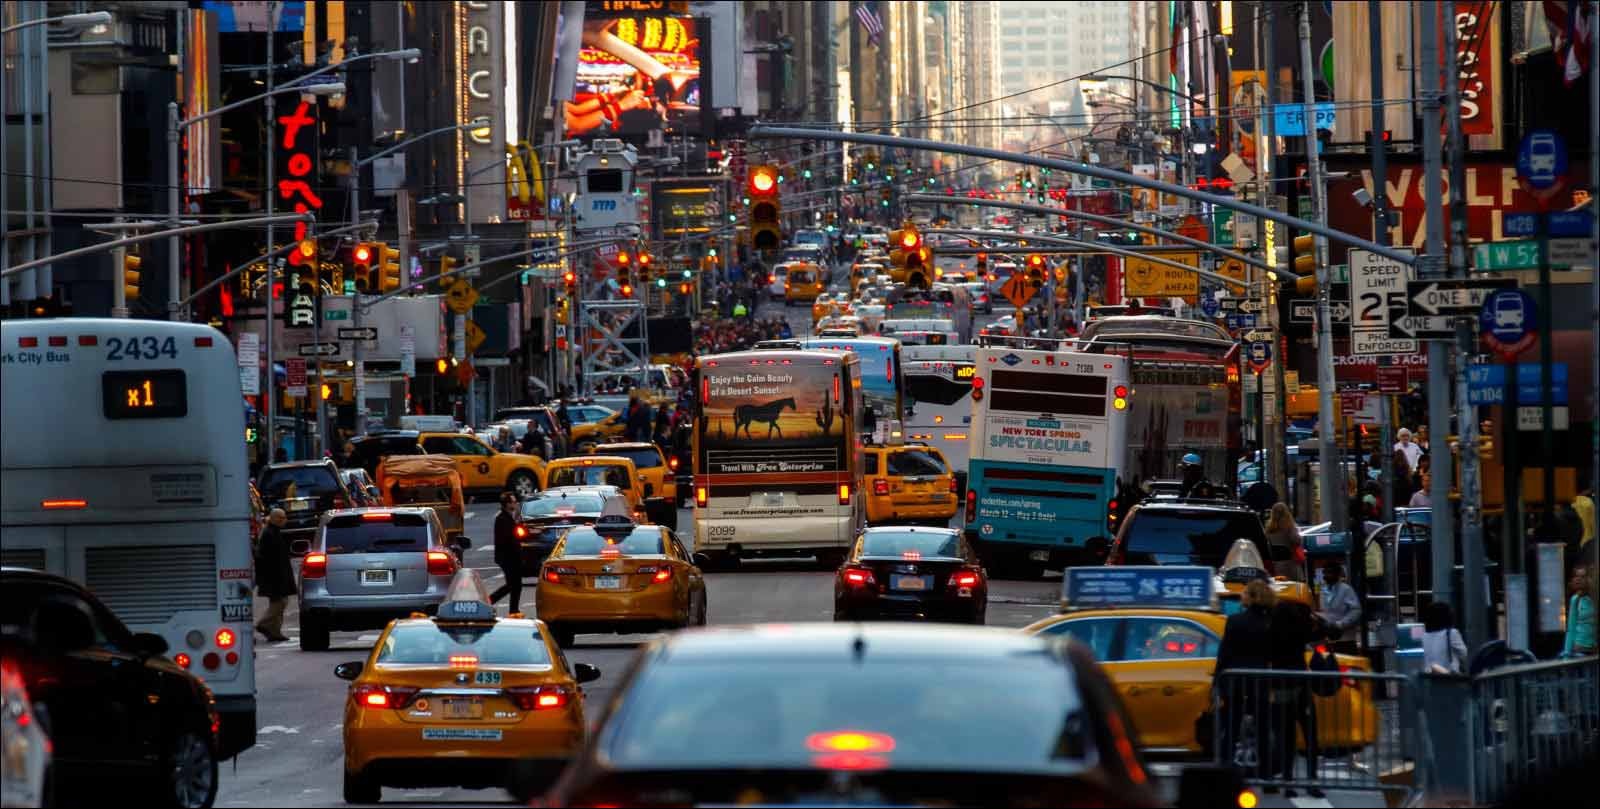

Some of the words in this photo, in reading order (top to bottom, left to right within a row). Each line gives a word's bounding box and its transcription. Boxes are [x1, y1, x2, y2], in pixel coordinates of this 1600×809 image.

[1496, 246, 1510, 265] W
[1164, 270, 1194, 279] ROUTE
[1362, 265, 1401, 275] SPEED
[1164, 284, 1195, 292] AHEAD
[1367, 278, 1397, 288] LIMIT
[1427, 291, 1459, 305] ONE
[1360, 292, 1408, 320] 25
[1404, 318, 1432, 330] ONE
[105, 335, 178, 361] 2434
[1358, 341, 1412, 351] ENFORCED
[18, 352, 43, 366] City
[46, 351, 70, 363] Bus
[711, 375, 732, 385] Enjoy
[733, 374, 745, 383] the
[747, 374, 766, 383] Calm
[767, 373, 793, 383] Beauty
[127, 380, 154, 406] x1
[711, 388, 720, 396] of
[727, 387, 752, 396] Desert
[1002, 427, 1022, 435] NEW
[1024, 428, 1047, 437] YORK
[1049, 430, 1081, 439] SPRING
[990, 434, 1092, 453] SPECTACULAR
[721, 464, 741, 472] Travel
[741, 463, 755, 472] With
[756, 463, 777, 472] Free
[778, 461, 824, 473] Enterprise
[980, 507, 1000, 517] March
[1017, 511, 1030, 521] May
[710, 526, 736, 536] 2099
[1162, 586, 1203, 598] SALE
[454, 601, 478, 613] 4N99
[476, 671, 501, 684] 439
